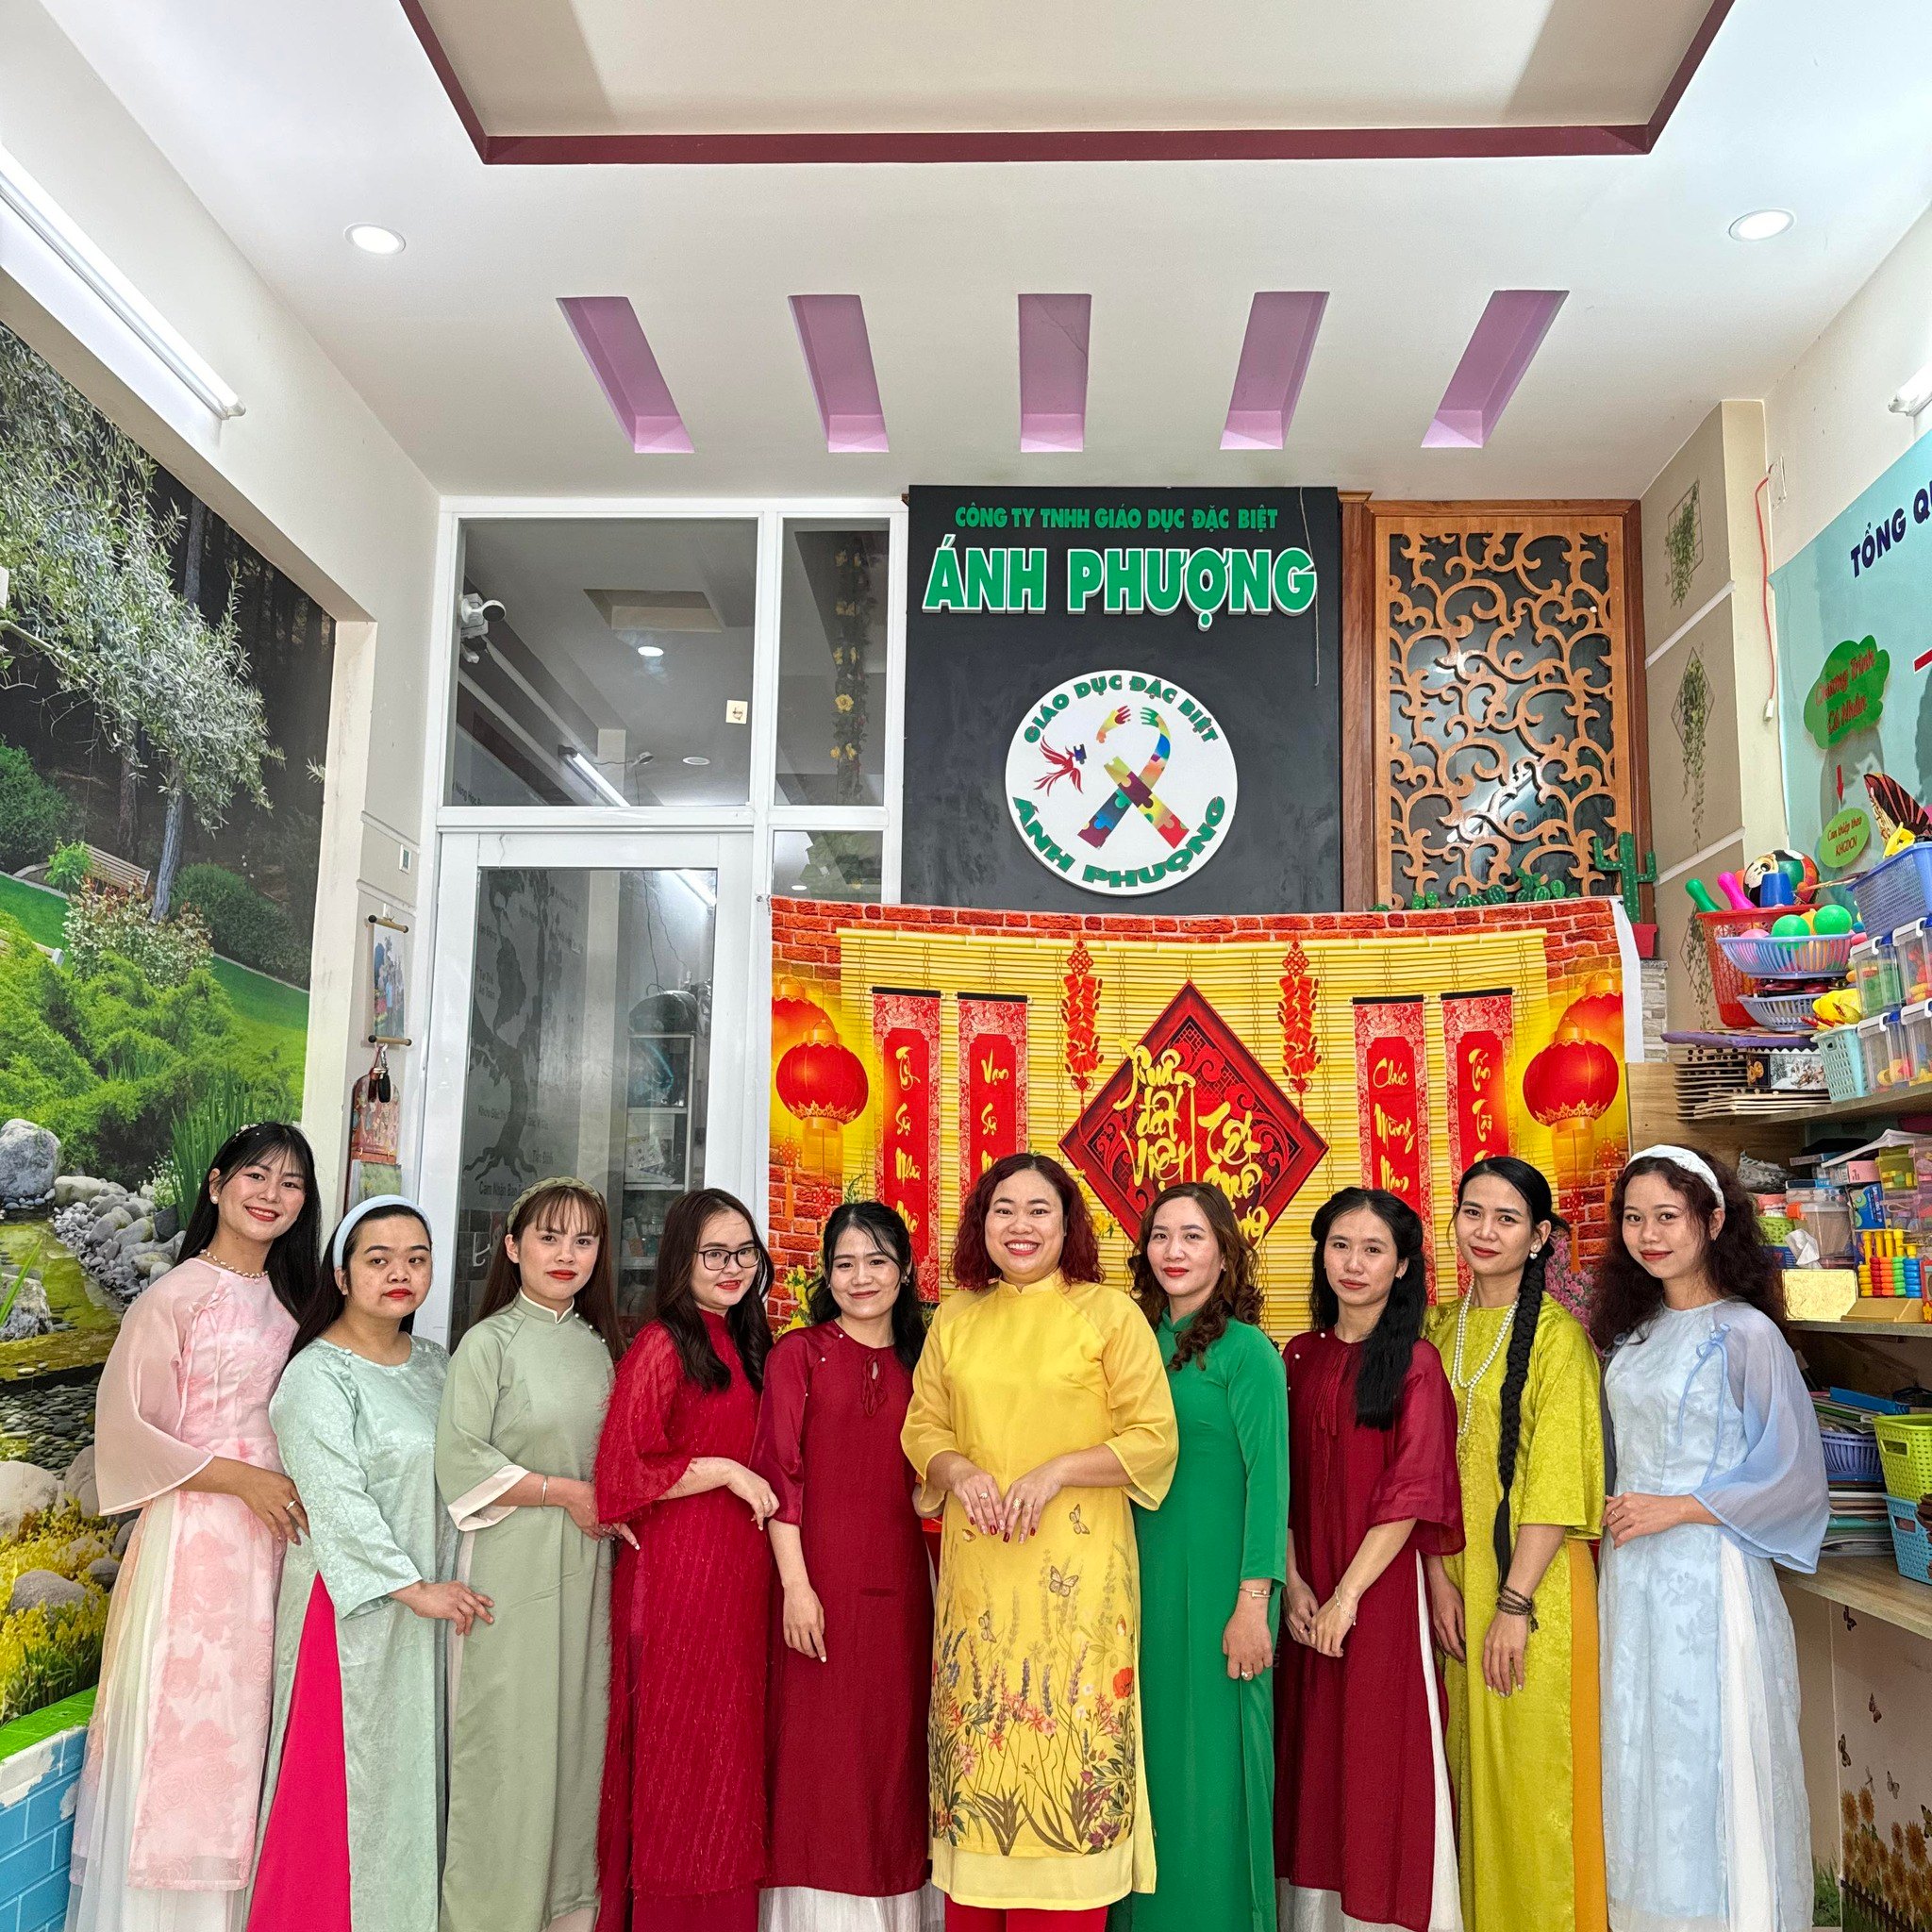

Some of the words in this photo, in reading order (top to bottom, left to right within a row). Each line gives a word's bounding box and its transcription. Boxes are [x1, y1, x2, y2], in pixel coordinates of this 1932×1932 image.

[956, 502, 1007, 528] CÔNG
[1012, 508, 1034, 528] TY
[1041, 508, 1090, 528] TNHH
[1094, 503, 1141, 528] GIÁO
[1147, 508, 1184, 533] DỤC
[1191, 504, 1229, 533] ĐẶC
[1238, 504, 1277, 533] BIỆT
[1851, 508, 1906, 578] TỔNG
[1913, 480, 1932, 525] Q
[922, 534, 1046, 614] ÁNH
[1067, 547, 1317, 631] PHƯỢNG
[1024, 693, 1070, 743] GIÁO
[1074, 675, 1123, 699] DỤC
[1129, 675, 1178, 705] ĐẶC
[1177, 698, 1219, 742] BIỆT
[1012, 796, 1075, 873] ÁNH
[981, 1047, 1009, 1086] Vạn
[1373, 1057, 1410, 1089] Chúc
